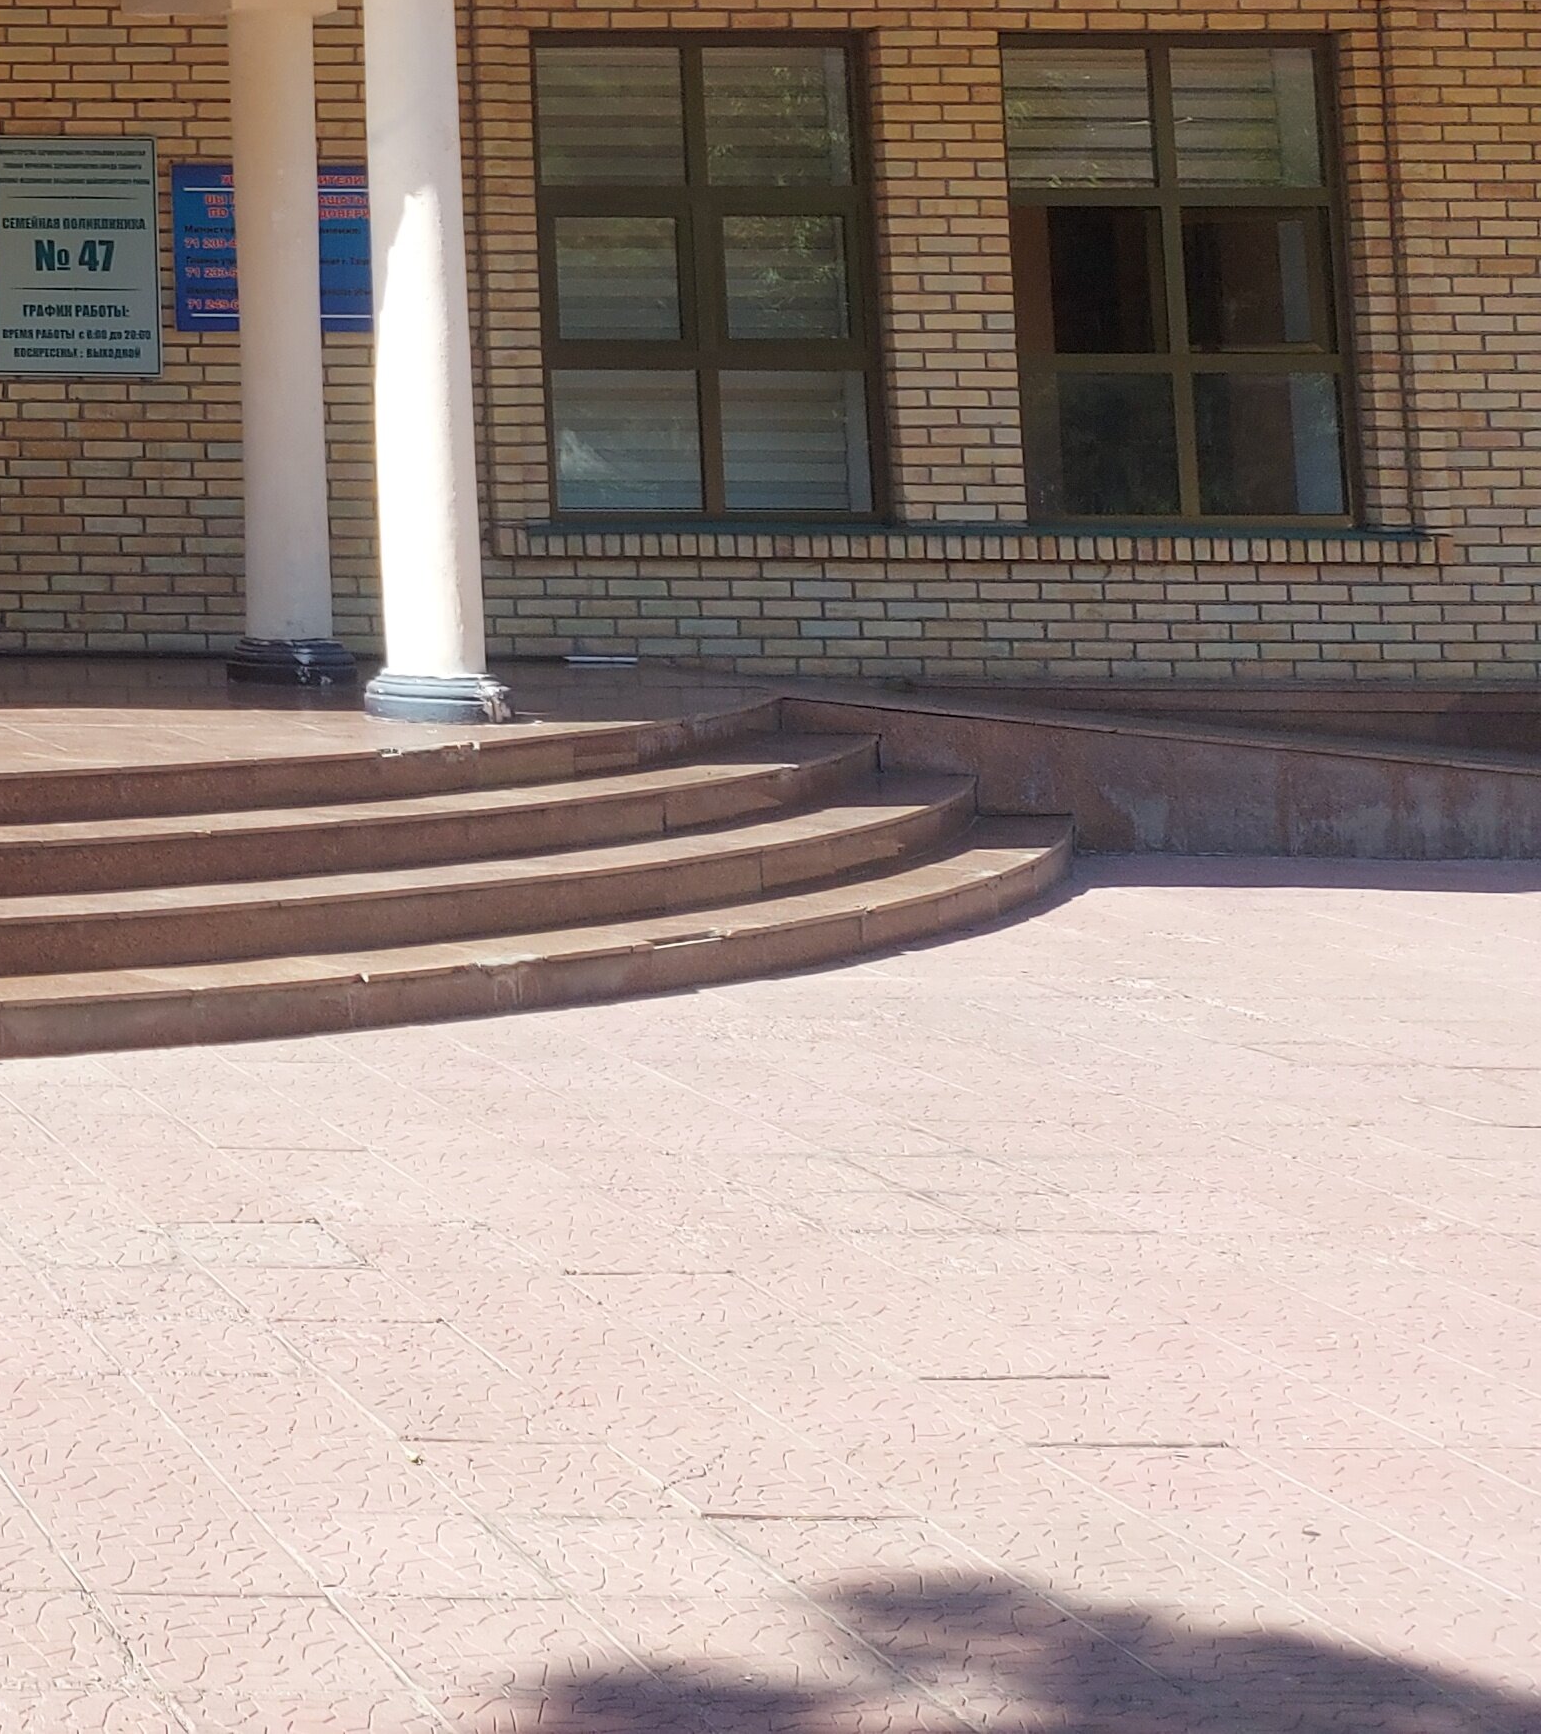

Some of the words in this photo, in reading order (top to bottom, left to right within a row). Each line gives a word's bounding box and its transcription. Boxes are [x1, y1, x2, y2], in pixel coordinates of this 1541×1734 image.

[2, 216, 60, 230] СЕМЕЙНАЯ
[63, 218, 147, 230] ПОЛИКЛИНИКА
[78, 239, 115, 272] 47
[22, 304, 72, 317] ГРАФИК
[75, 304, 130, 317] РАБОТЫ:
[2, 329, 34, 339] ВРЕМЯ
[35, 329, 75, 339] РАБОТЫ
